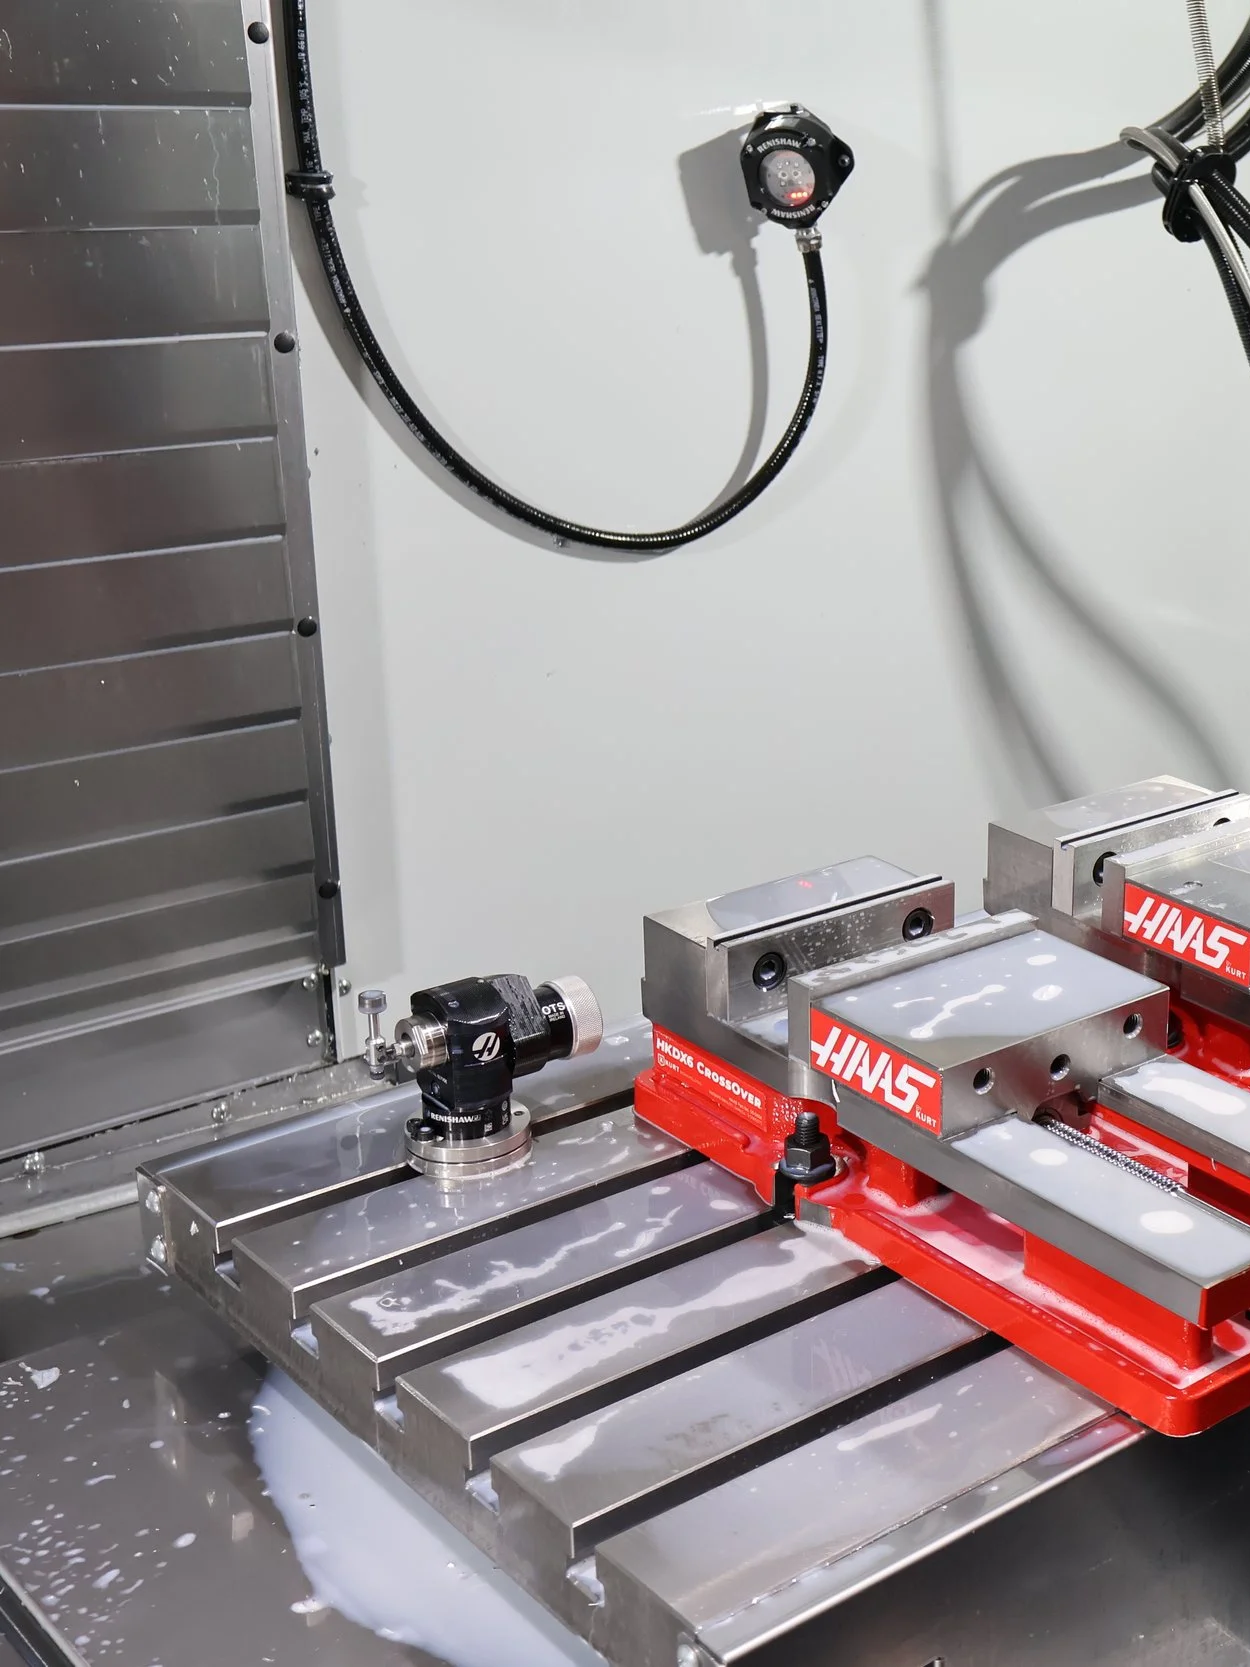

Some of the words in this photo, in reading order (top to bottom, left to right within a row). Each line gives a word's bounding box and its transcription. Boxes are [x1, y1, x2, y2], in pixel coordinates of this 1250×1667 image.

[757, 138, 802, 153] RENISHAW
[771, 203, 816, 218] RENISHAW
[1124, 896, 1248, 969] HAAS
[1225, 965, 1247, 980] KURT
[541, 1001, 566, 1015] OTS
[656, 1038, 694, 1068] HKDX6
[811, 1025, 937, 1114] HAAS
[430, 1112, 474, 1125] RENISHAW
[915, 1110, 937, 1128] KURT
